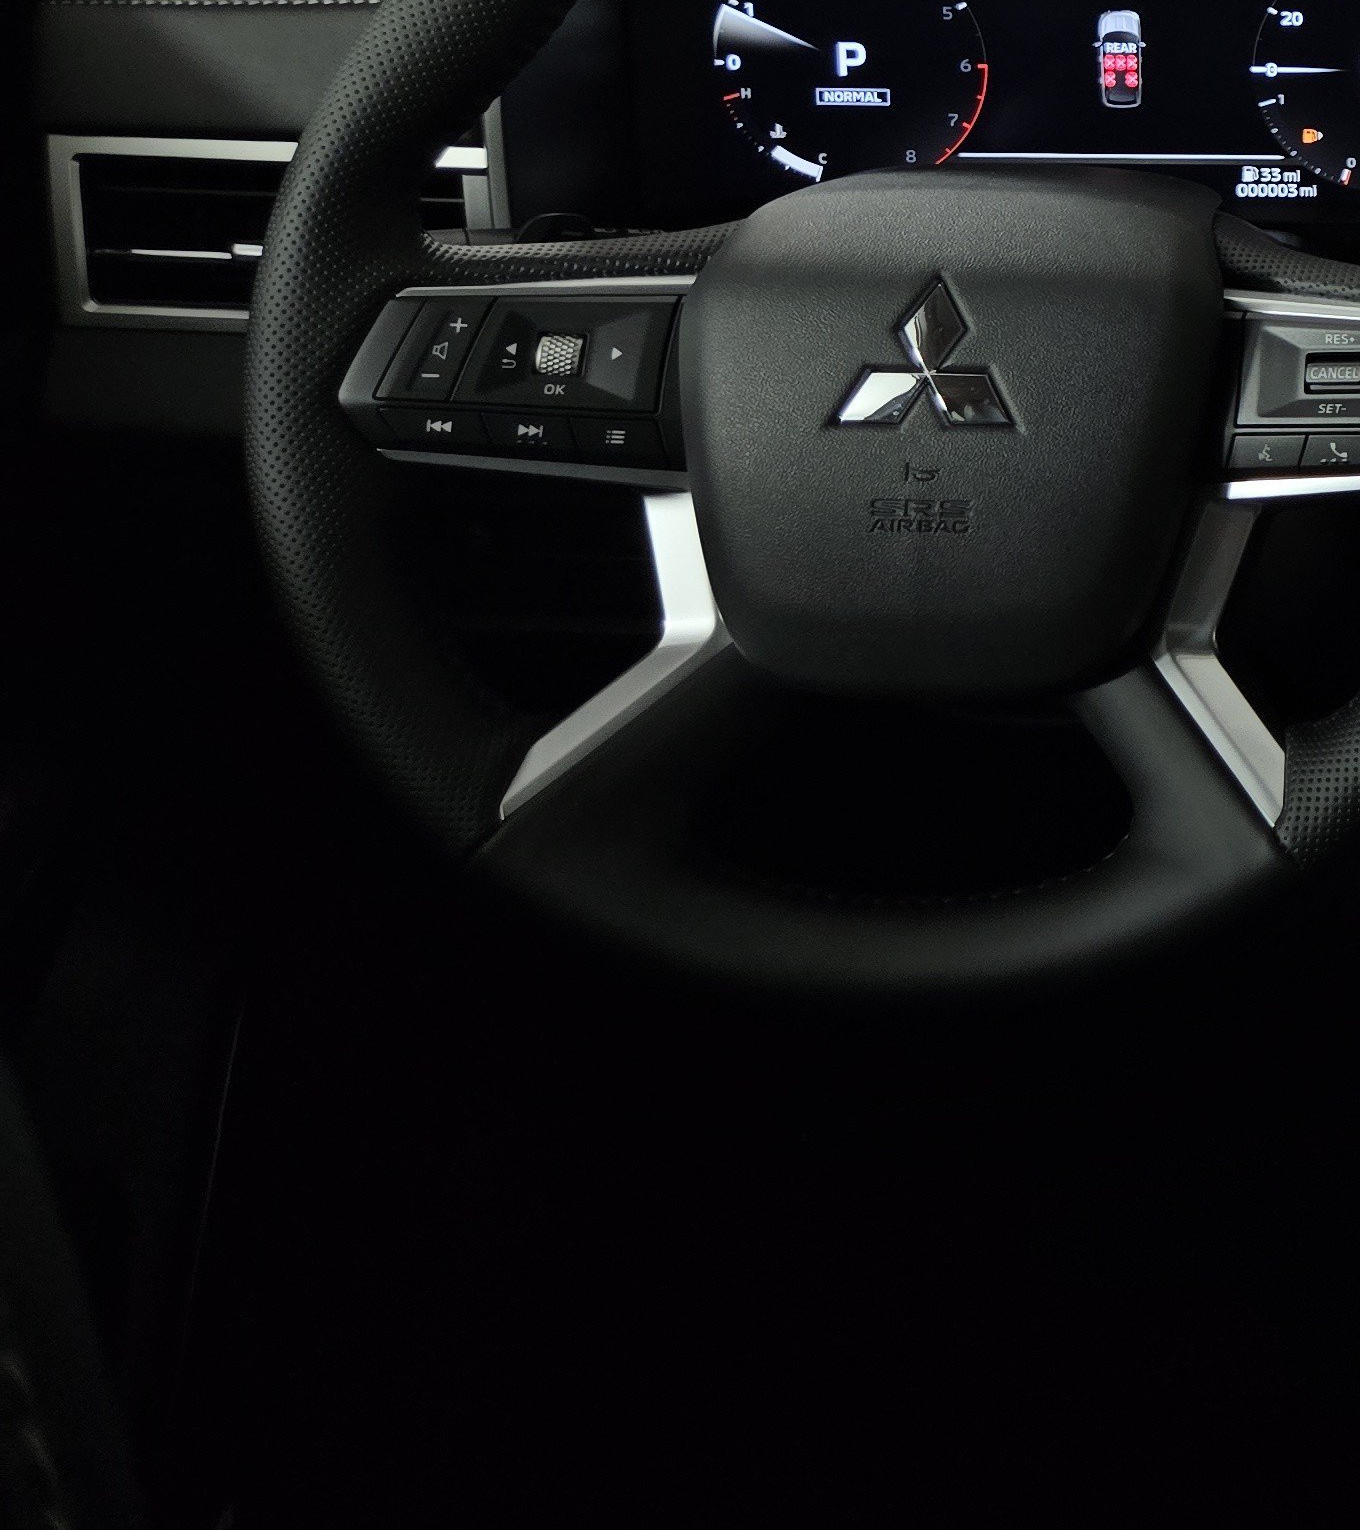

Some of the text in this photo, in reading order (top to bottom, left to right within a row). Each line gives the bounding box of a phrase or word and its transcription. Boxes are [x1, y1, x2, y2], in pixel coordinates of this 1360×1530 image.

[743, 2, 754, 17] 1
[943, 6, 953, 20] 5
[1280, 12, 1304, 27] 20
[1104, 42, 1138, 54] REAR
[725, 54, 742, 70] 0
[835, 41, 867, 77] P
[960, 59, 971, 72] 6
[740, 88, 752, 99] H
[823, 91, 883, 103] NORMAL
[947, 114, 959, 127] 7
[818, 153, 828, 165] C
[906, 150, 917, 163] 8
[1346, 157, 1356, 169] 0
[1260, 168, 1282, 182] 33
[1235, 183, 1298, 198] 000003
[1309, 366, 1360, 379] CANCEL
[543, 384, 566, 396] OK
[869, 498, 973, 519] SRS
[868, 519, 972, 534] AIRBAG
